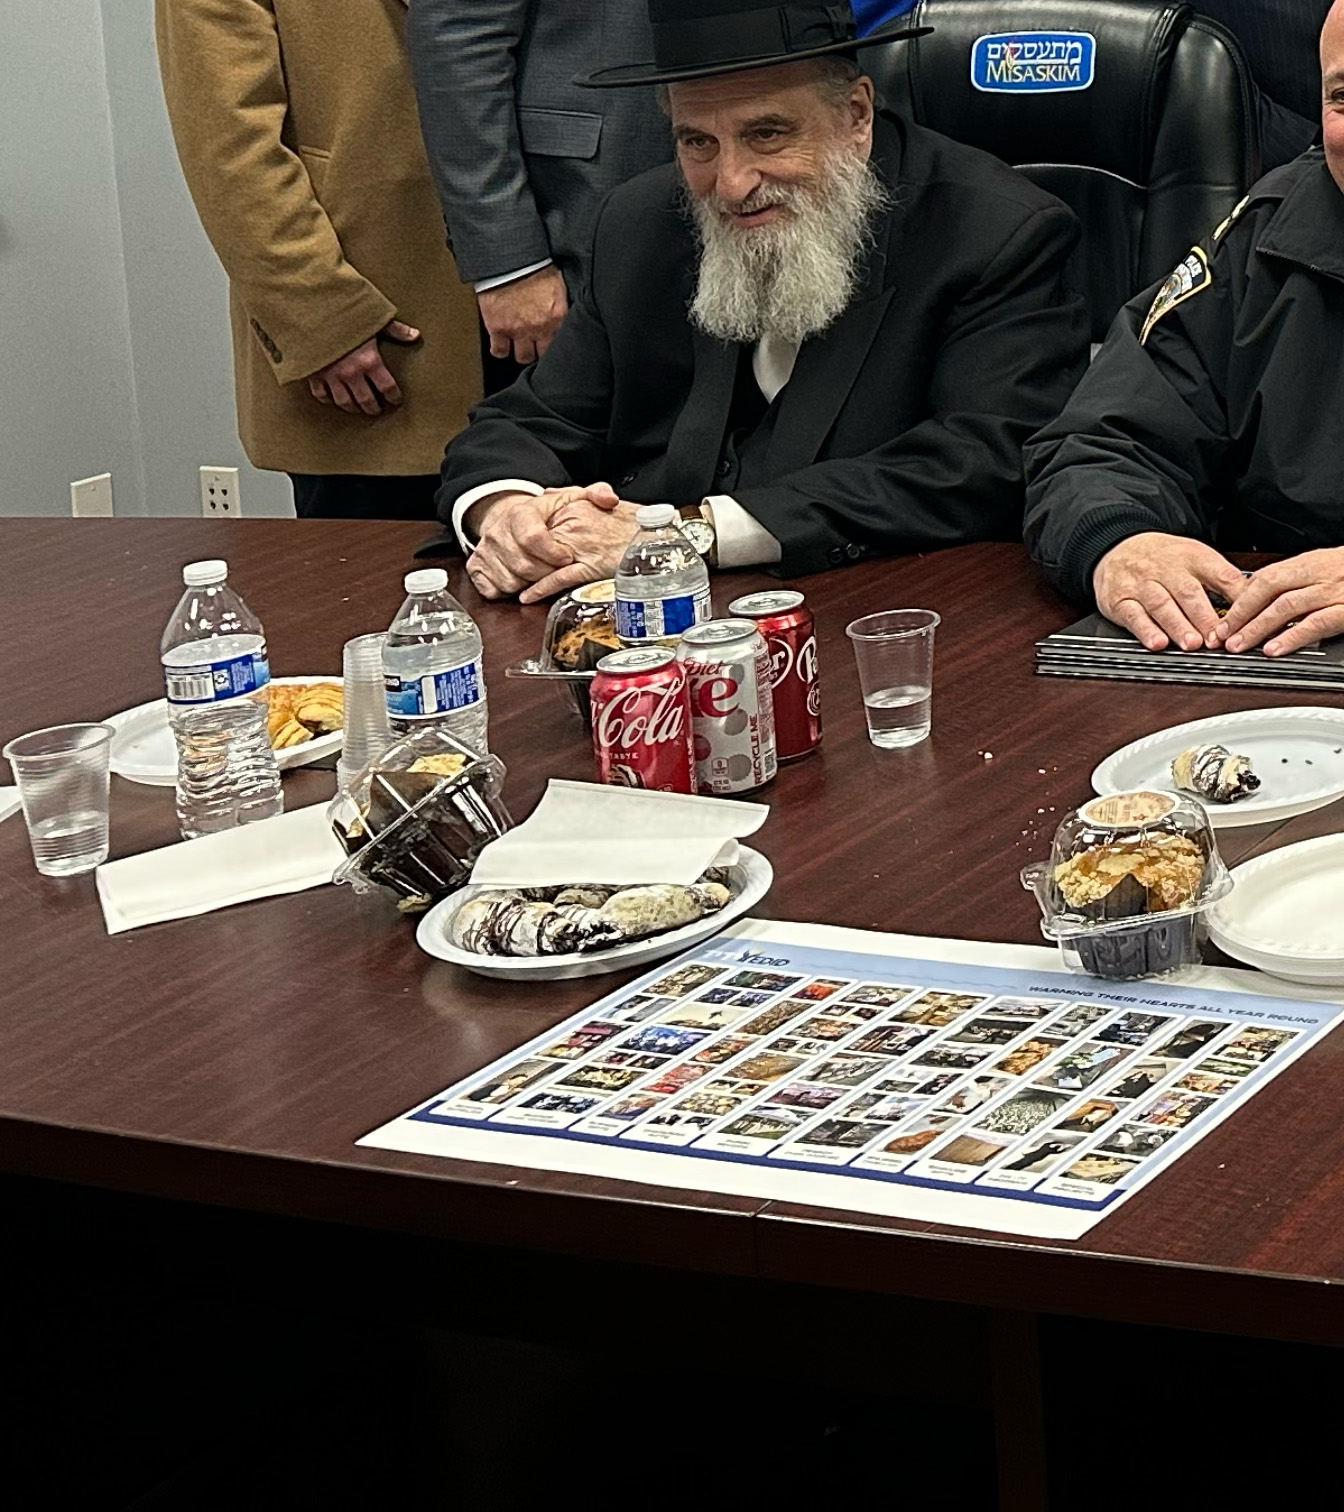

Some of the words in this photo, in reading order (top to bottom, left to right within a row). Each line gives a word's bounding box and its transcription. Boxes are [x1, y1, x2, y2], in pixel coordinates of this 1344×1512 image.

[598, 676, 685, 749] Cola
[1028, 985, 1094, 998] WARMING
[1097, 991, 1138, 1003] THEIR
[1138, 997, 1195, 1011] HEARTS
[1197, 1004, 1224, 1014] ALL
[1227, 1007, 1265, 1019] YEAR
[1267, 1012, 1320, 1024] ROUND
